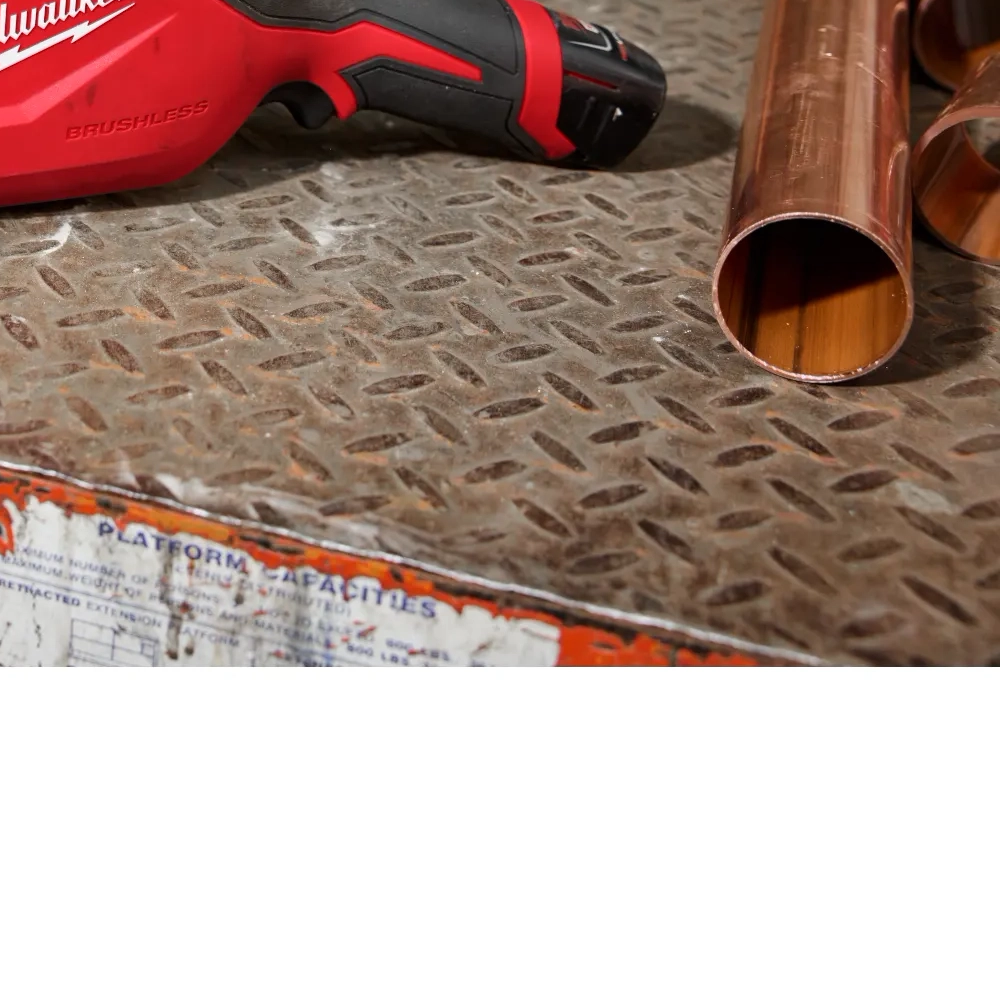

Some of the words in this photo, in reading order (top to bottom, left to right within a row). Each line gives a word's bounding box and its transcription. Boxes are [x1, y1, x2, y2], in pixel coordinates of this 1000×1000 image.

[65, 100, 209, 141] BRUSHLESS
[0, 555, 63, 578] MAXIMUM
[68, 557, 126, 580] NUMBER
[97, 520, 248, 570] PLATFORM
[262, 563, 437, 619] CAPACITIES
[86, 601, 163, 628] EXTENSION
